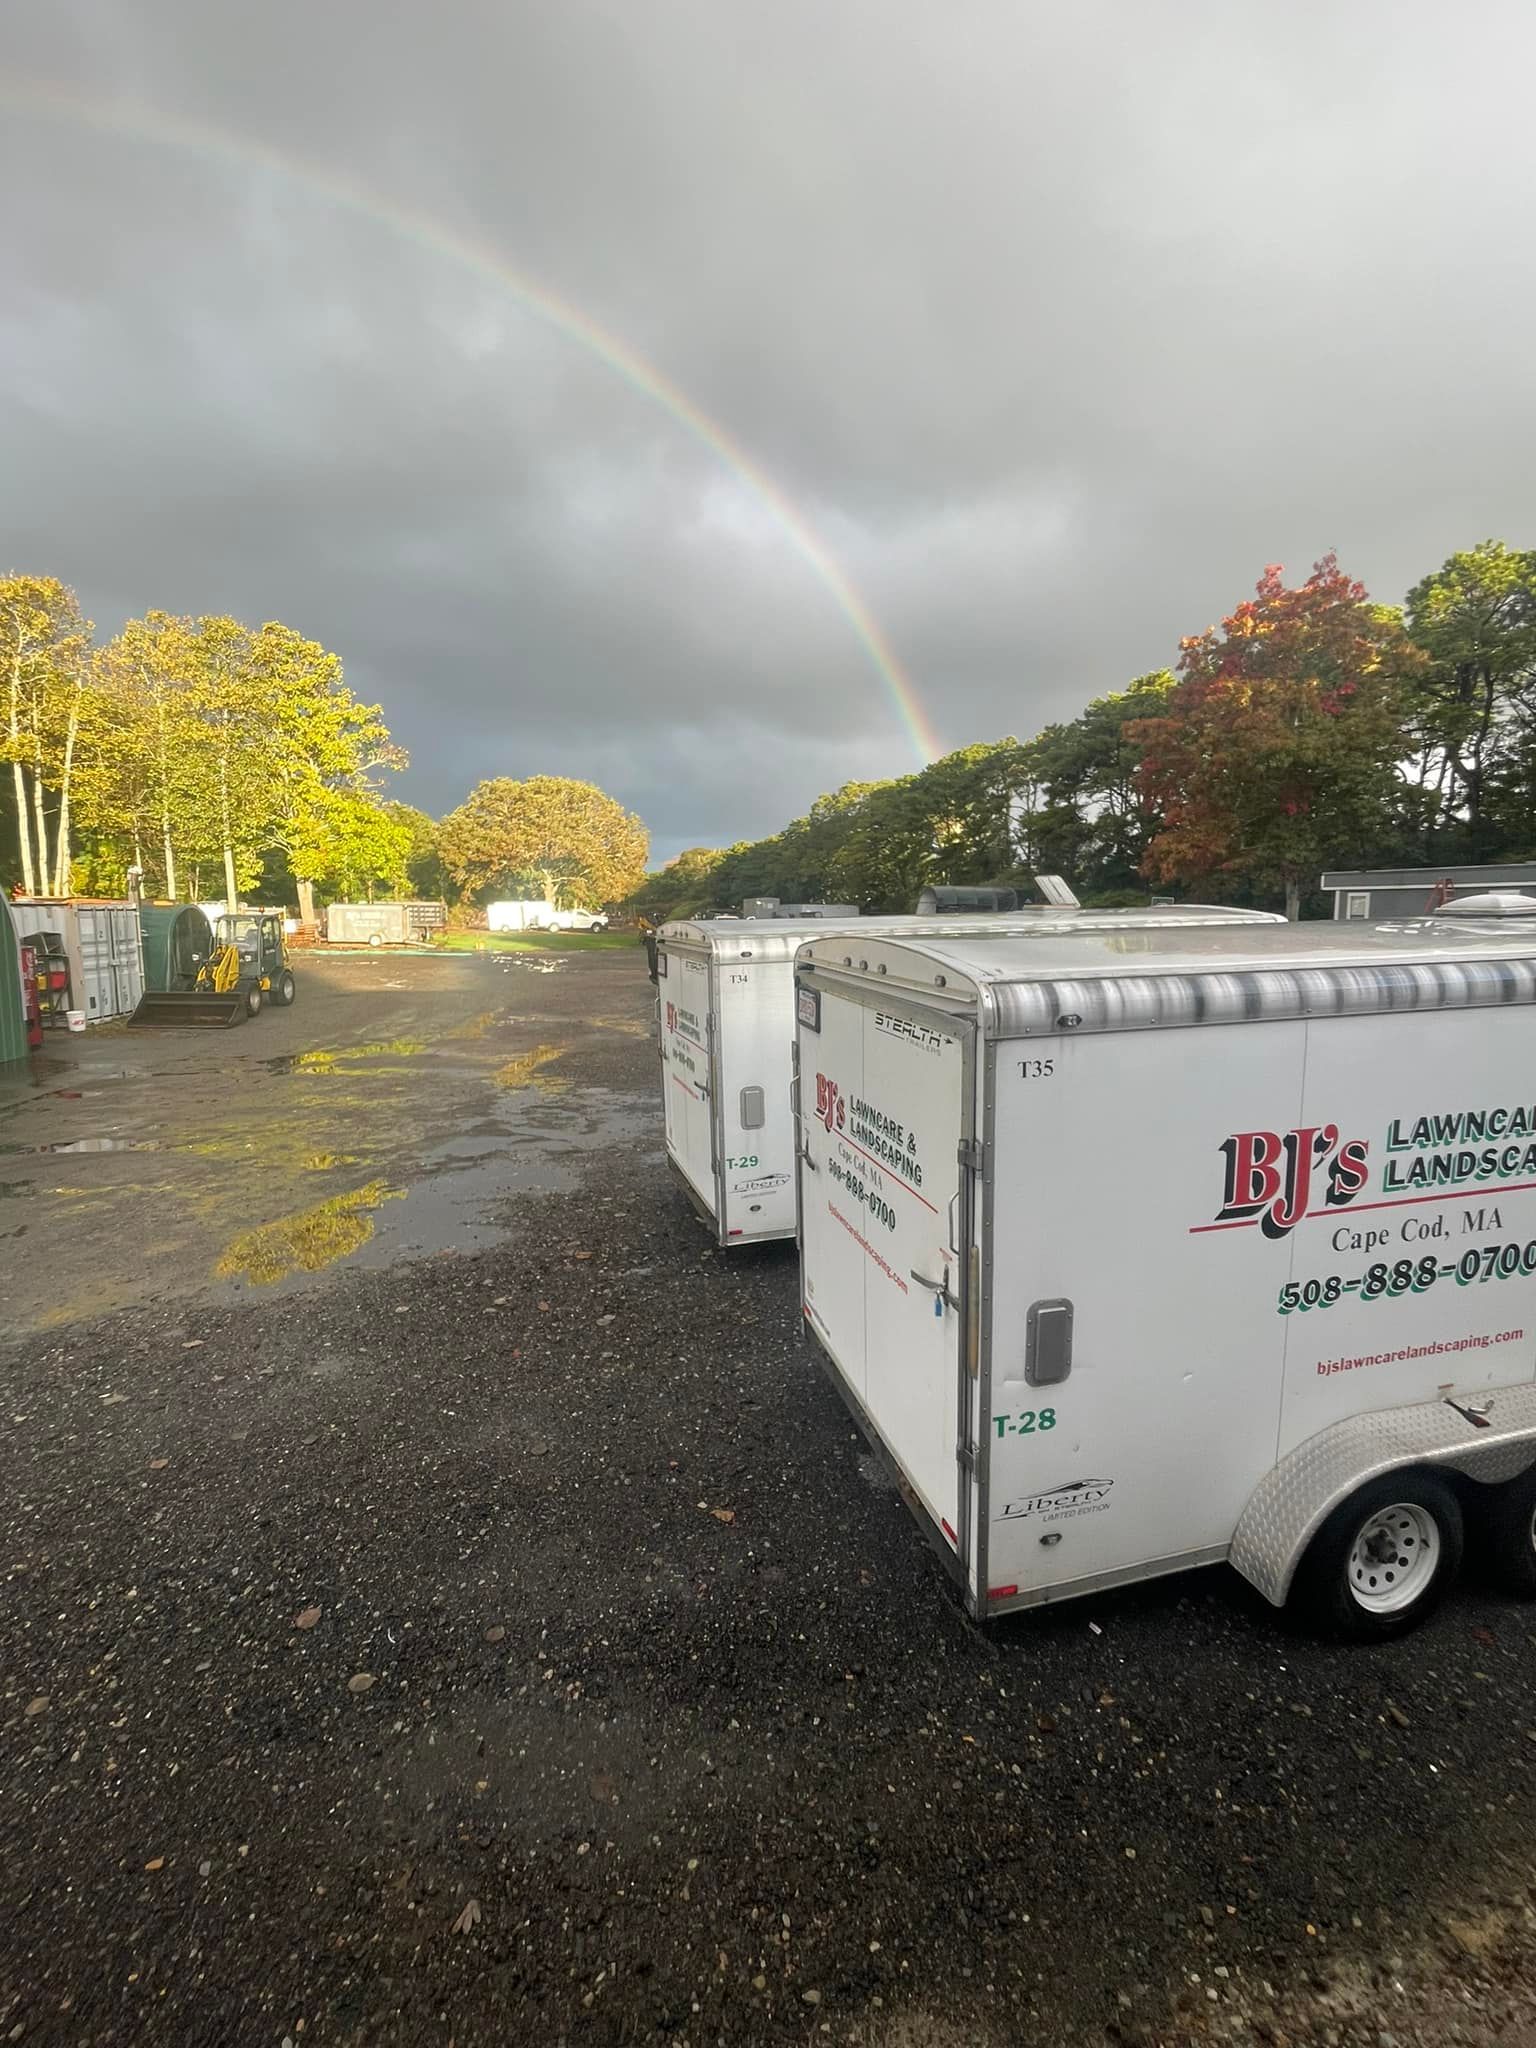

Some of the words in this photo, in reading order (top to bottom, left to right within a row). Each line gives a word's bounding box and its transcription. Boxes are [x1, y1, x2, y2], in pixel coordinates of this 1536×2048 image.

[729, 974, 749, 985] T34
[875, 1012, 942, 1047] STEALTH
[1017, 1059, 1054, 1078] T35
[816, 1072, 846, 1133] BJ's
[850, 1094, 904, 1147] LAWNCARE
[907, 1132, 917, 1156] &
[726, 1155, 759, 1170] T-29
[850, 1117, 922, 1188] LANDSCAPING
[1382, 1143, 1536, 1192] LANDSCA
[1215, 1123, 1369, 1239] BJ's
[1331, 1227, 1390, 1253] Cape
[1400, 1215, 1450, 1243] Cod,
[1460, 1207, 1504, 1234] MA
[1316, 1328, 1524, 1376] bjslawncarelandscaping.com
[992, 1407, 1056, 1438] T-28
[1001, 1487, 1112, 1515] Liberty
[1042, 1508, 1076, 1522] LIMITED
[1077, 1502, 1111, 1516] EDITION
